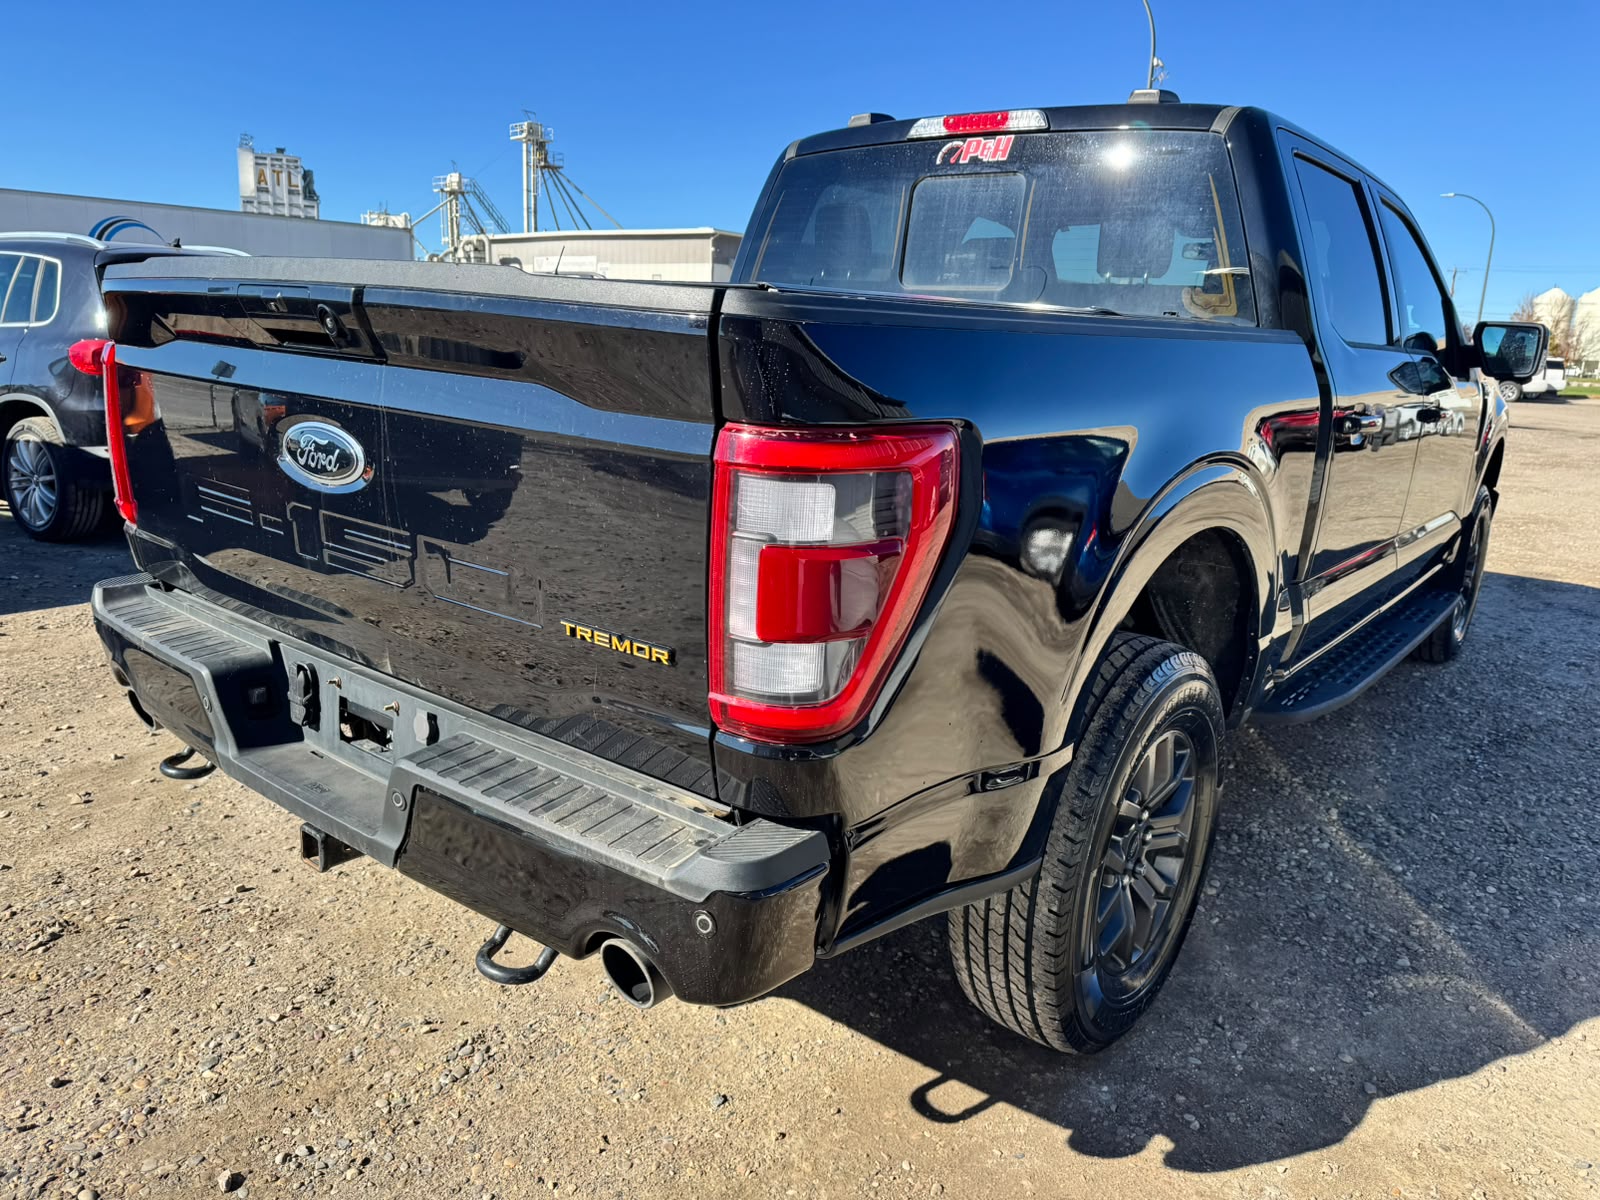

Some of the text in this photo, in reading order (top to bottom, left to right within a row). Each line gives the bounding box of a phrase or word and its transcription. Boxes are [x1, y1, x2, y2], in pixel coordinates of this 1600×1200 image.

[959, 135, 1015, 164] P&H
[297, 433, 340, 473] Ford
[187, 477, 543, 629] F-150
[560, 619, 671, 666] TREMOR
